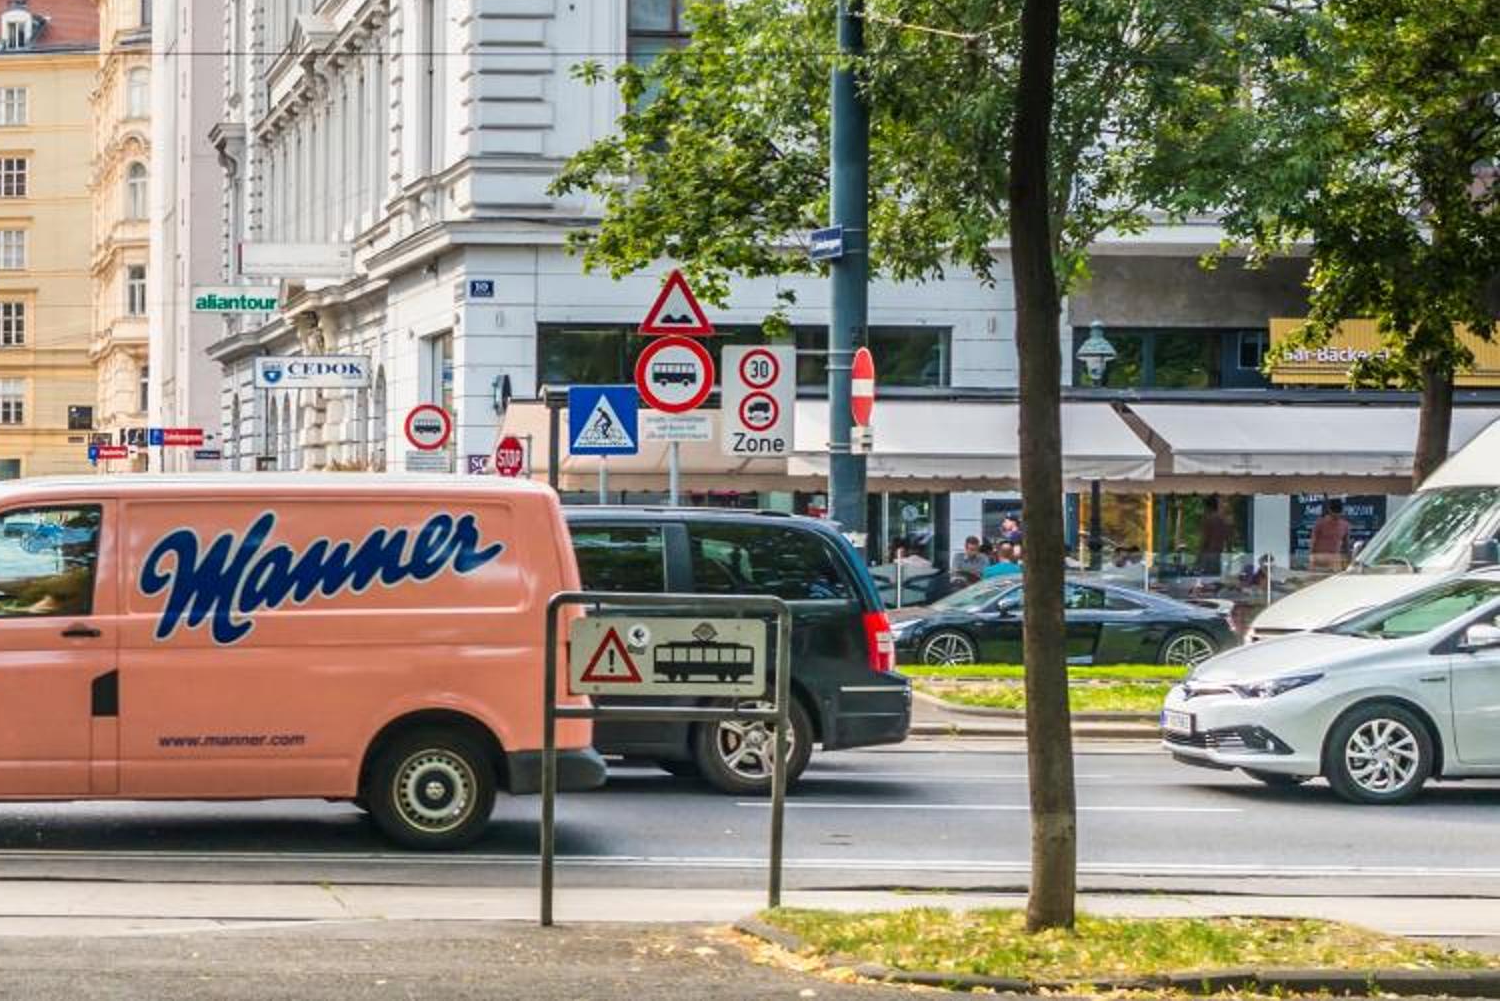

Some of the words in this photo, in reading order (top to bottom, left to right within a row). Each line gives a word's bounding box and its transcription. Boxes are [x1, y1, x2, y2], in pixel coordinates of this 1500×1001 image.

[195, 293, 277, 311] aliantour
[749, 359, 769, 379] 30
[733, 432, 785, 453] Zone
[497, 449, 521, 467] STOP
[138, 510, 504, 645] Manner
[159, 734, 305, 747] www.manner.com
